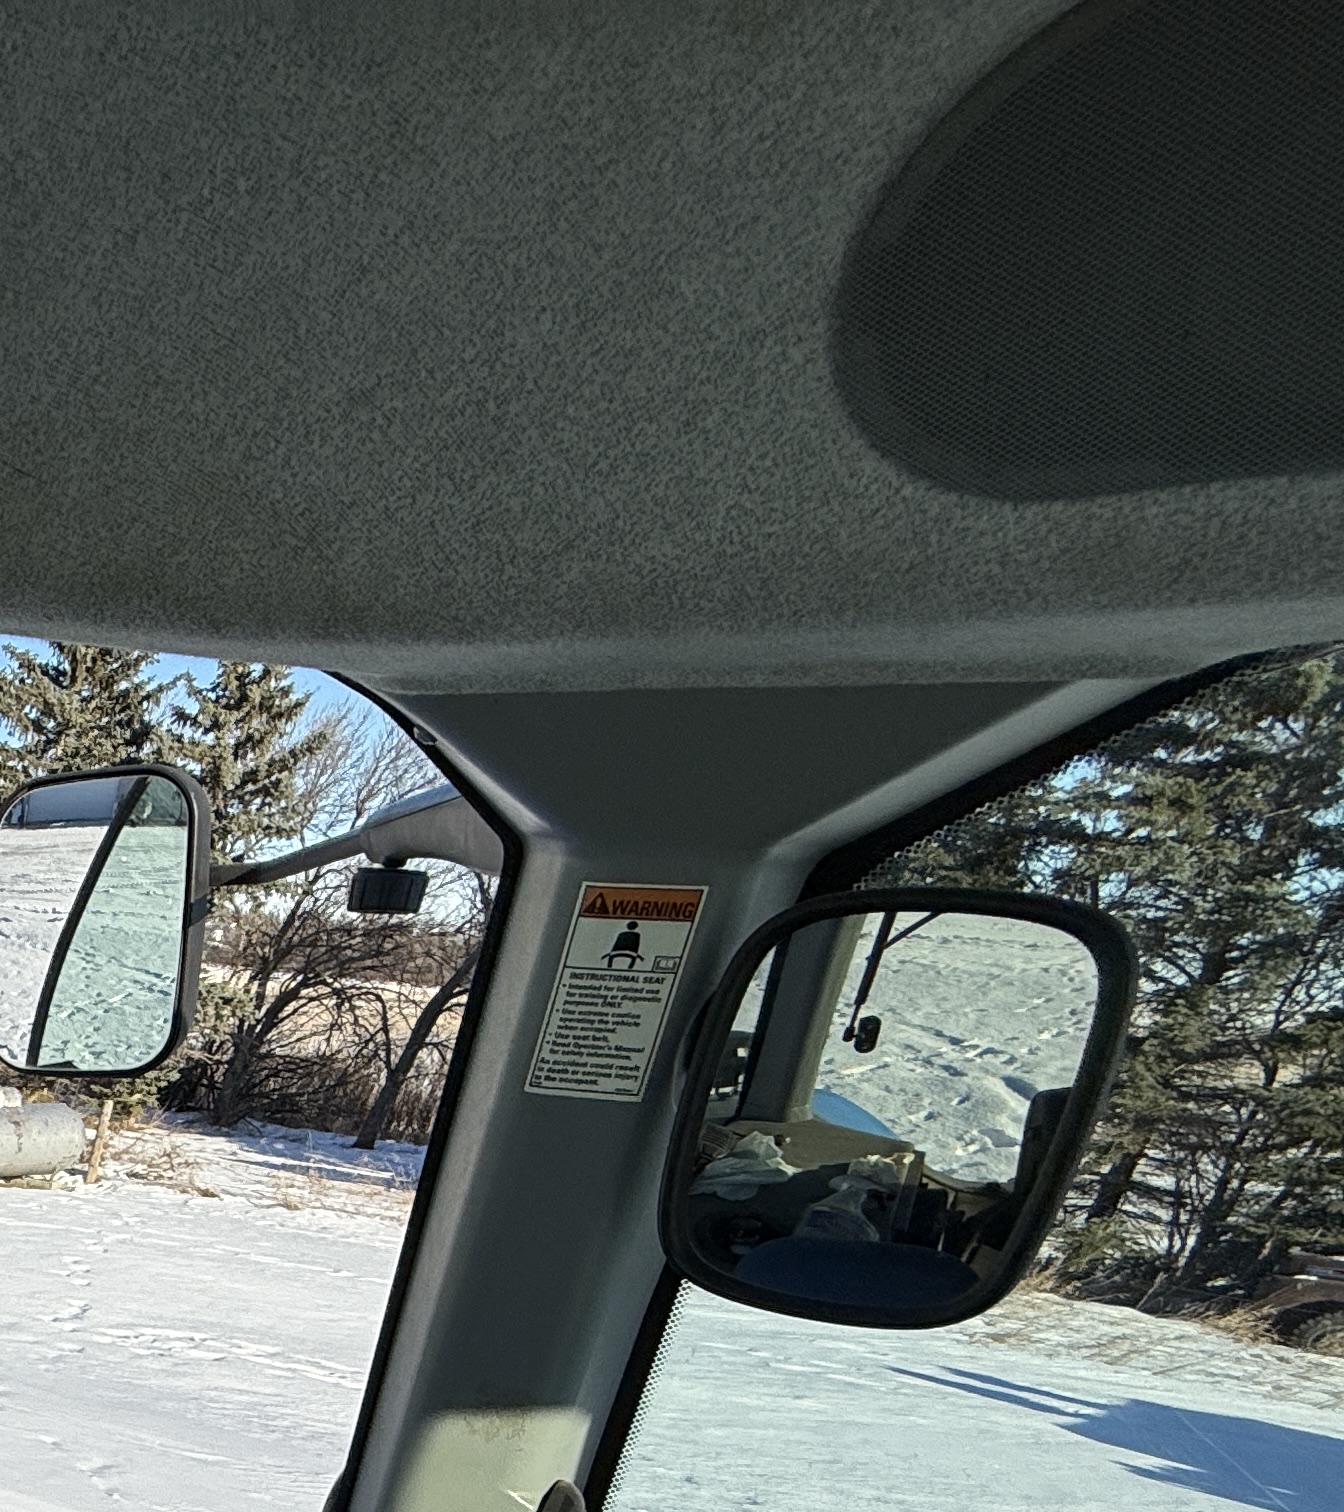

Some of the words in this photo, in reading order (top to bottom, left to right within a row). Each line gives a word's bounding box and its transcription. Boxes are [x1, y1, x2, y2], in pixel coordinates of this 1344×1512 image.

[610, 899, 696, 919] WARNING
[569, 972, 640, 984] INSTRUCTIONAL
[642, 976, 666, 984] SEAT
[568, 983, 602, 992] Intended
[554, 1031, 570, 1039] Use
